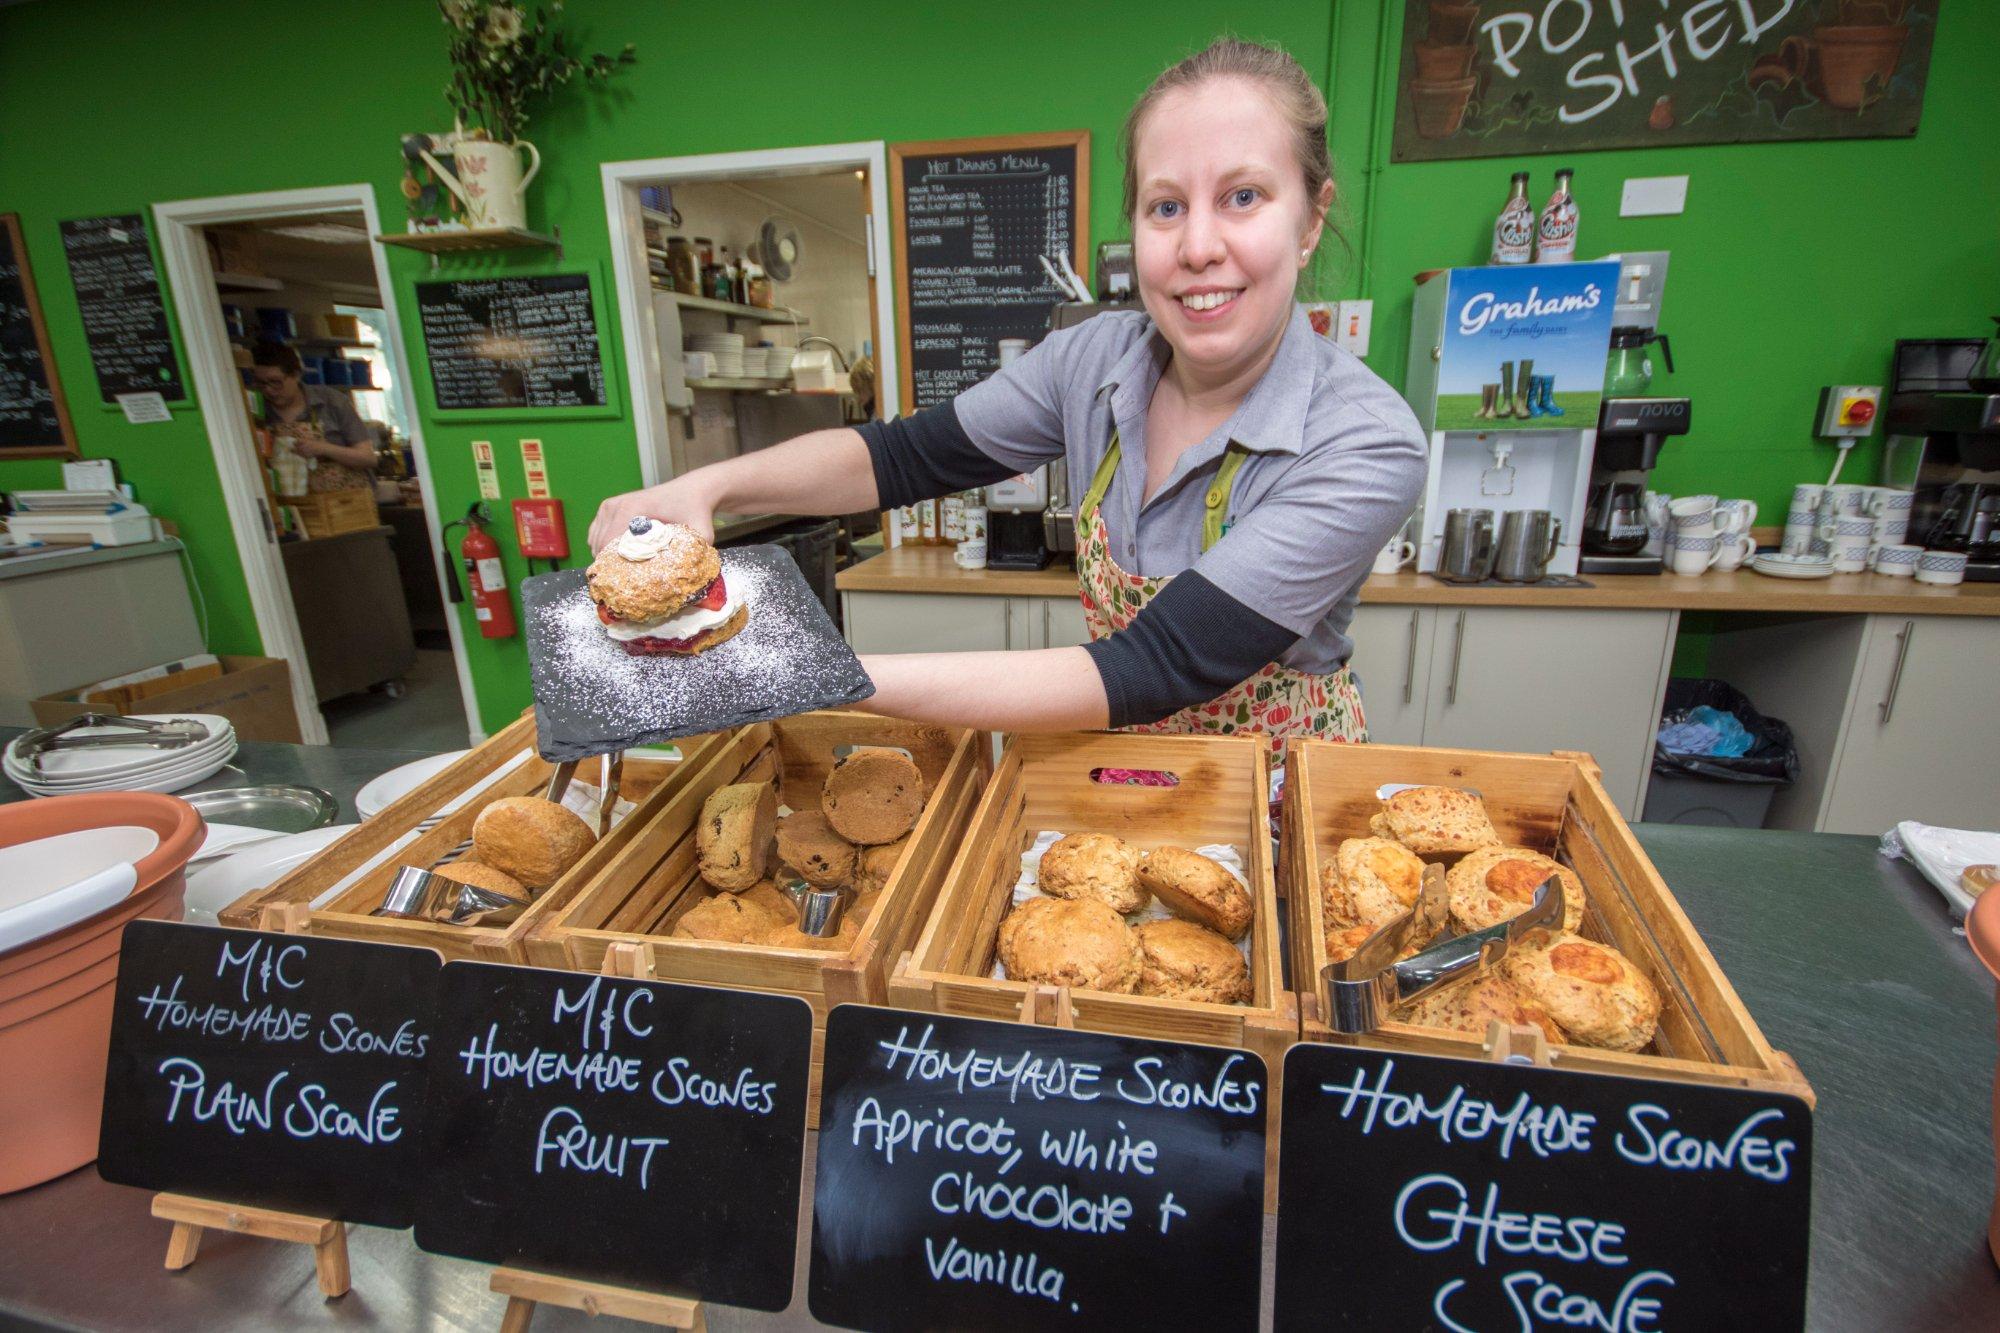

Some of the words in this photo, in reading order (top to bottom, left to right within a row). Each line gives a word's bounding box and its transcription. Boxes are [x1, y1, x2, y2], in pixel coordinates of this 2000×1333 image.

[1558, 0, 1796, 124] SHED
[927, 160, 950, 176] HOT
[956, 156, 997, 172] DRINKS
[1002, 153, 1040, 170] MENU
[1459, 283, 1602, 336] Graham's
[1502, 321, 1546, 339] family
[933, 369, 977, 380] CHOCOLATE
[961, 349, 987, 357] LARGE
[216, 937, 308, 1002] M&C
[137, 974, 311, 1042] HOMEMADE
[319, 1012, 430, 1058] SCONES
[552, 975, 654, 1051] M&C
[158, 1057, 290, 1135] PLAIN
[283, 1078, 403, 1144] SCONE
[459, 1022, 642, 1093] HOMEMADE
[651, 1057, 777, 1114] SCONES
[879, 1023, 1102, 1104] HOMEMADE
[1116, 1054, 1261, 1115] SCONES
[535, 1105, 670, 1191] FRUIT
[851, 1096, 1024, 1175] Apricot,
[1320, 1057, 1597, 1159] HOMEMADE
[1614, 1102, 1797, 1184] SCONES
[1394, 1174, 1629, 1266] CHEESE
